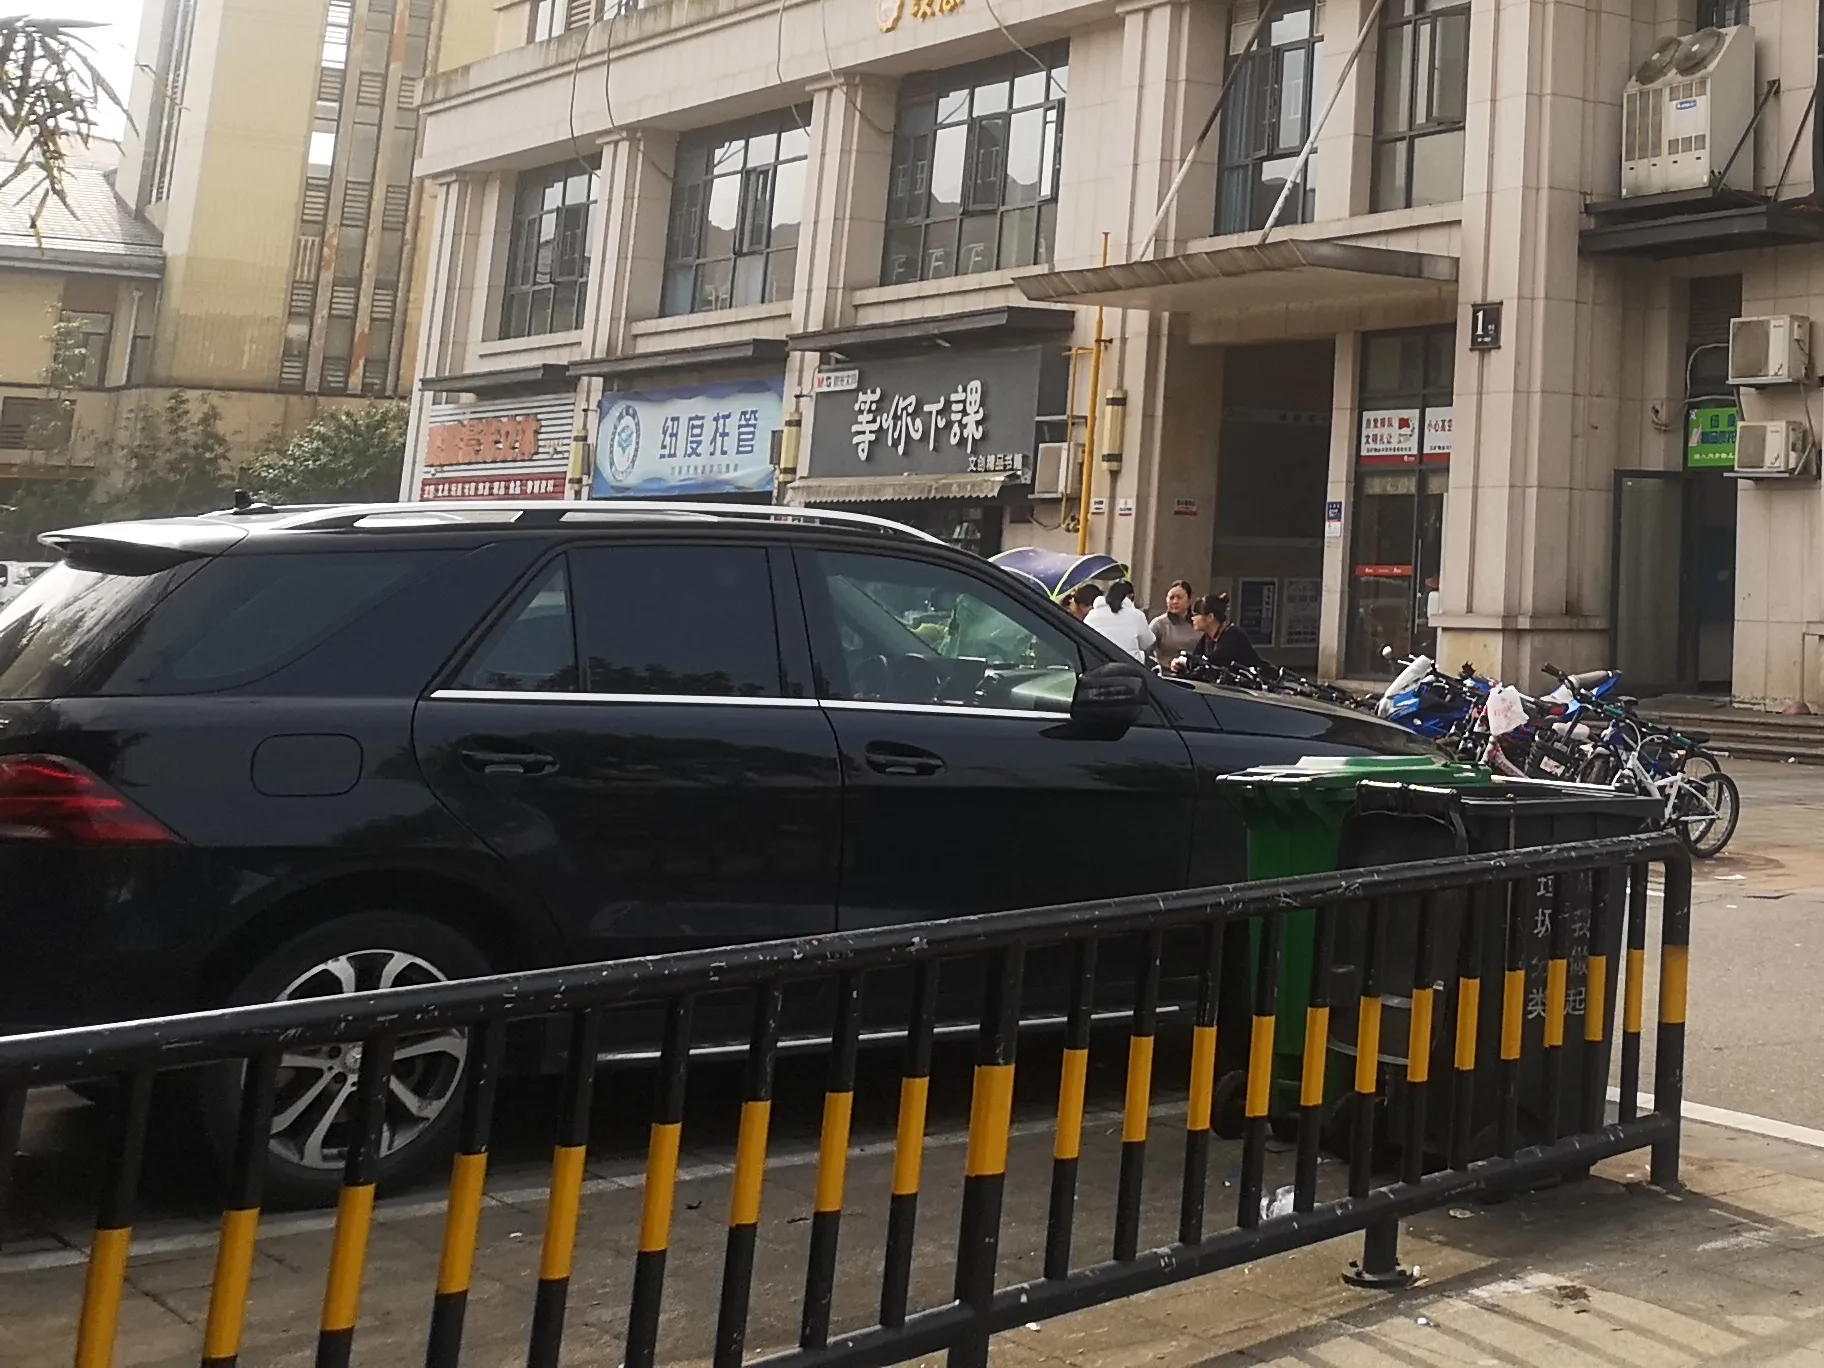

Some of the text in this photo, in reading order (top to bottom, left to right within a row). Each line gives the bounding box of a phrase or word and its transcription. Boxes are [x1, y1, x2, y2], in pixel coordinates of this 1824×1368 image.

[1475, 309, 1484, 335] 1
[659, 409, 758, 459] 纽度托管
[851, 379, 984, 462] 等你下課
